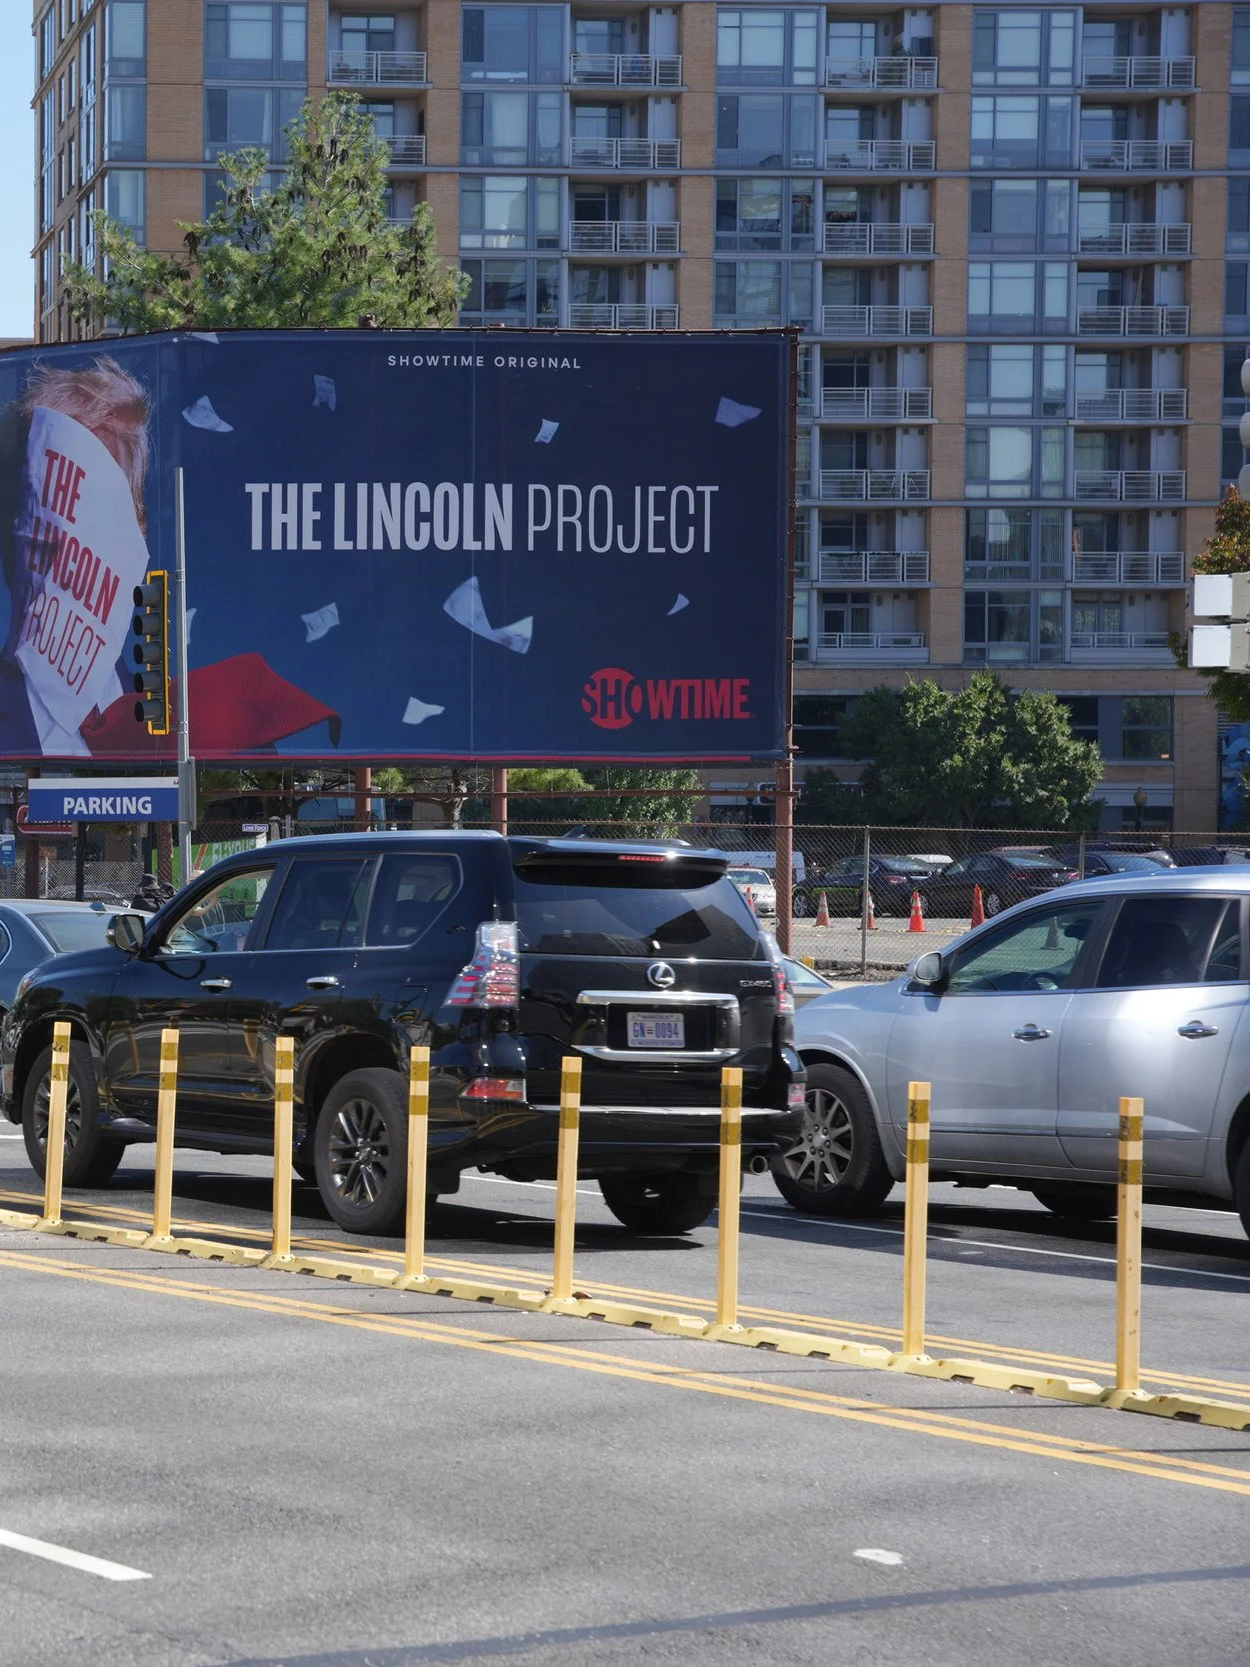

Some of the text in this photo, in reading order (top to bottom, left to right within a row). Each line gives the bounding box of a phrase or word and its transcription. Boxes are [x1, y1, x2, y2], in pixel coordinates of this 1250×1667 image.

[387, 354, 581, 369] SHOWTIME ORIGINAL
[40, 449, 86, 524] THE
[245, 481, 719, 553] THE LINCOLN PROJECT
[29, 516, 120, 626] LINCOLN
[581, 667, 751, 730] SHOWTIME
[63, 796, 152, 815] PARKING
